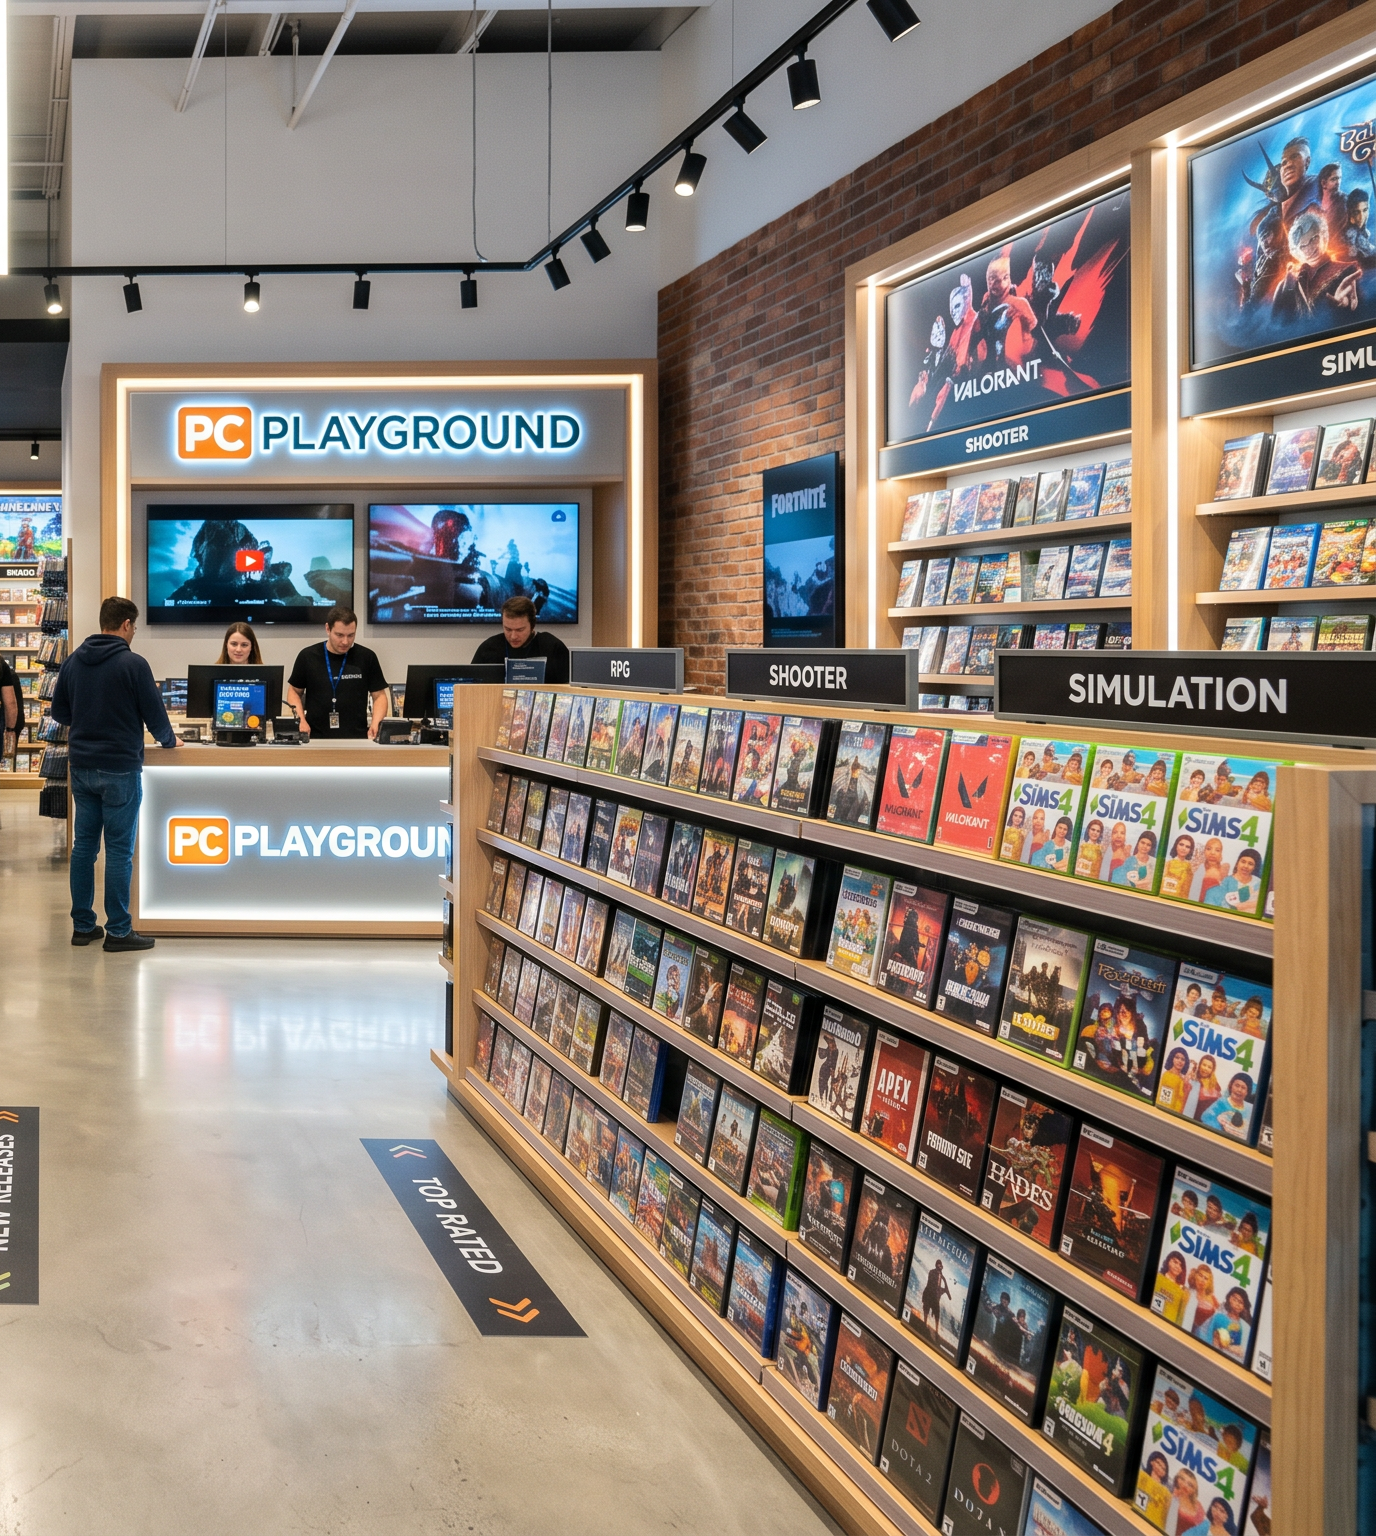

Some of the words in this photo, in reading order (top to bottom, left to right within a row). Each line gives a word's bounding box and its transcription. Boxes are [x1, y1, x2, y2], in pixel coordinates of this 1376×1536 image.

[953, 358, 1042, 403] VALORANT
[184, 414, 246, 452] PC
[262, 414, 580, 451] PLAYGROUND
[965, 425, 1029, 454] SHOOTER
[771, 483, 827, 519] FORTNITE
[610, 659, 631, 678] RPG
[769, 664, 848, 690] SHOOTER
[1068, 672, 1288, 714] SIMULATION
[1057, 788, 1074, 816] 4
[1139, 800, 1157, 830] 4
[174, 826, 224, 857] PC
[1239, 815, 1260, 848] 4
[1233, 1039, 1255, 1073] 4
[876, 1067, 912, 1106] APEX
[987, 1159, 1054, 1213] HADES
[412, 1177, 458, 1210] TOP
[435, 1213, 504, 1274] RATED
[1230, 1253, 1252, 1289] 4
[890, 1438, 924, 1477] DOTA
[924, 1472, 933, 1485] 2
[1213, 1466, 1236, 1502] 4
